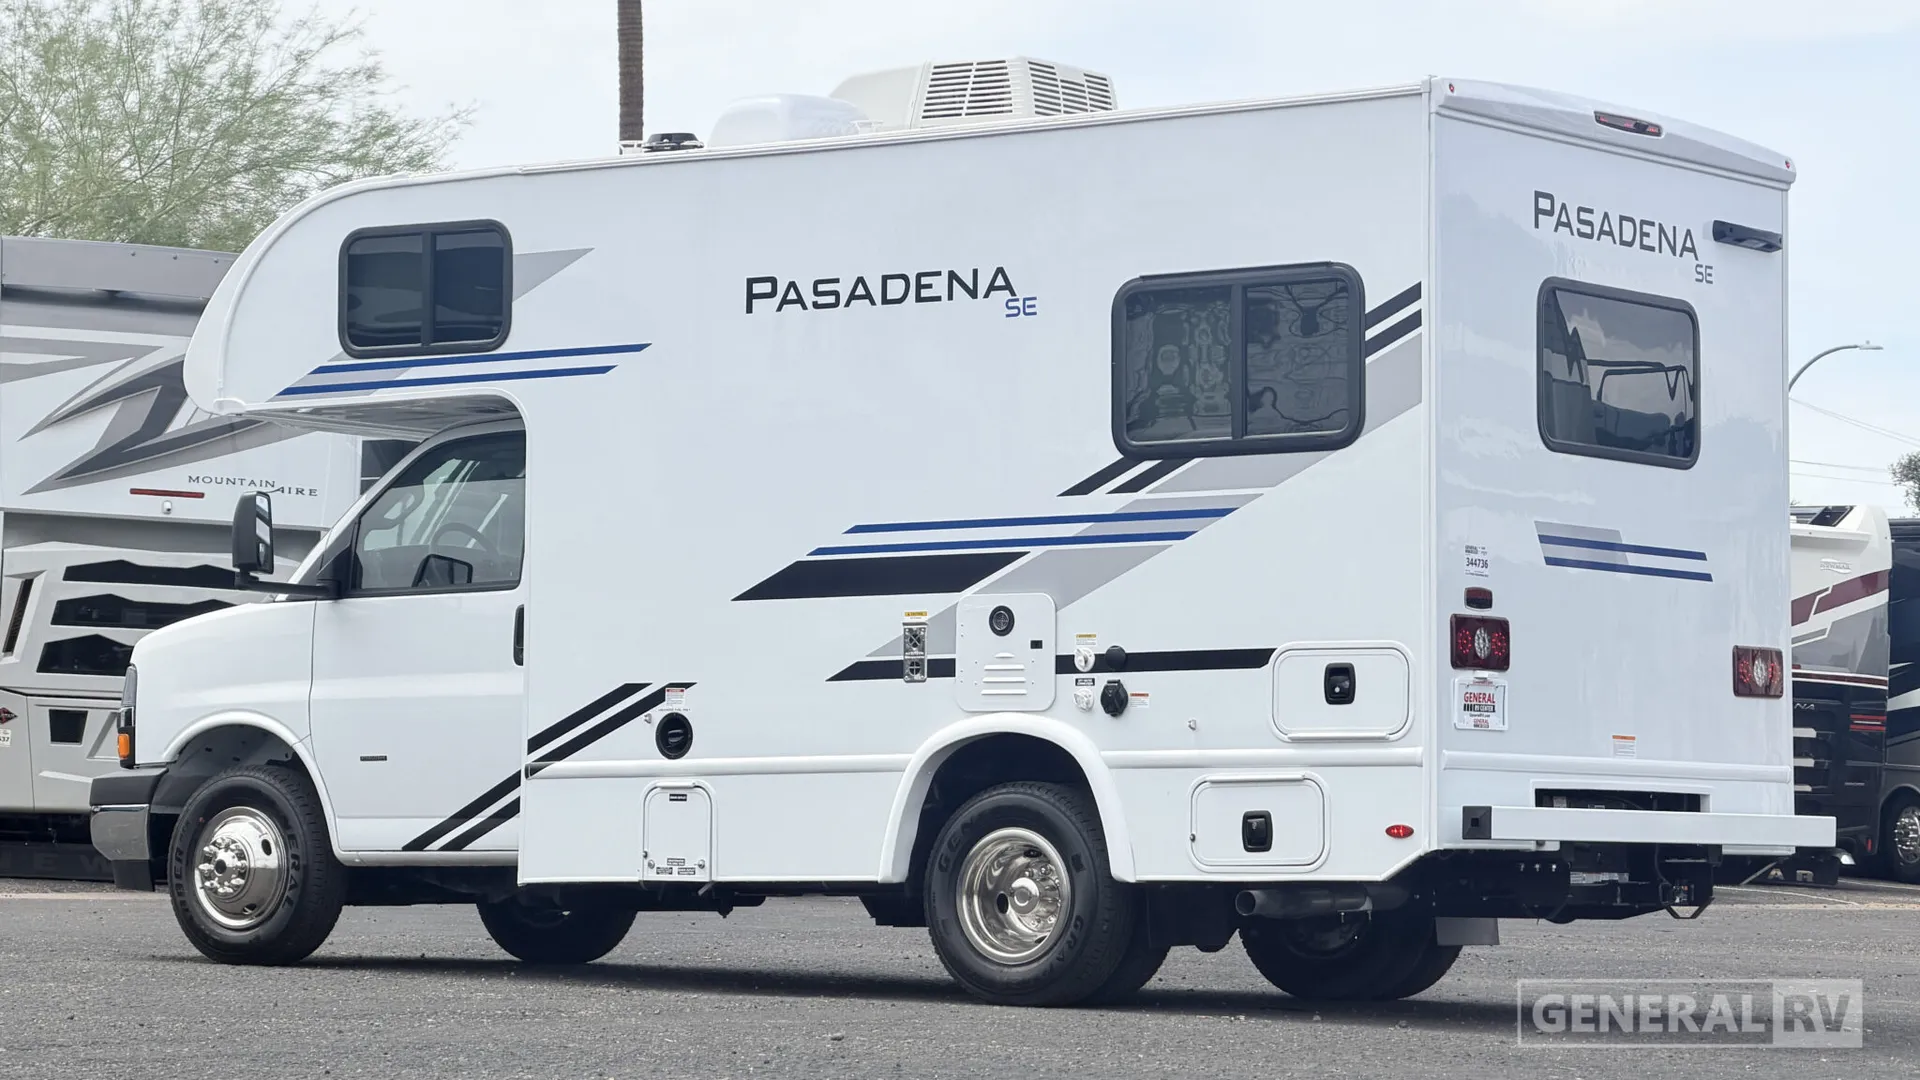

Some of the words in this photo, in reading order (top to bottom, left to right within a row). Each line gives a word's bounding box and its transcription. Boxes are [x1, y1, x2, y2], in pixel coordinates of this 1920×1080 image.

[1533, 190, 1699, 261] PASADENA
[1694, 263, 1714, 285] SE
[745, 266, 1018, 314] PASADENA
[1005, 296, 1038, 318] SE
[187, 475, 276, 488] MOUNTAIN
[1465, 557, 1489, 569] 344736
[1463, 691, 1496, 704] GENERAL
